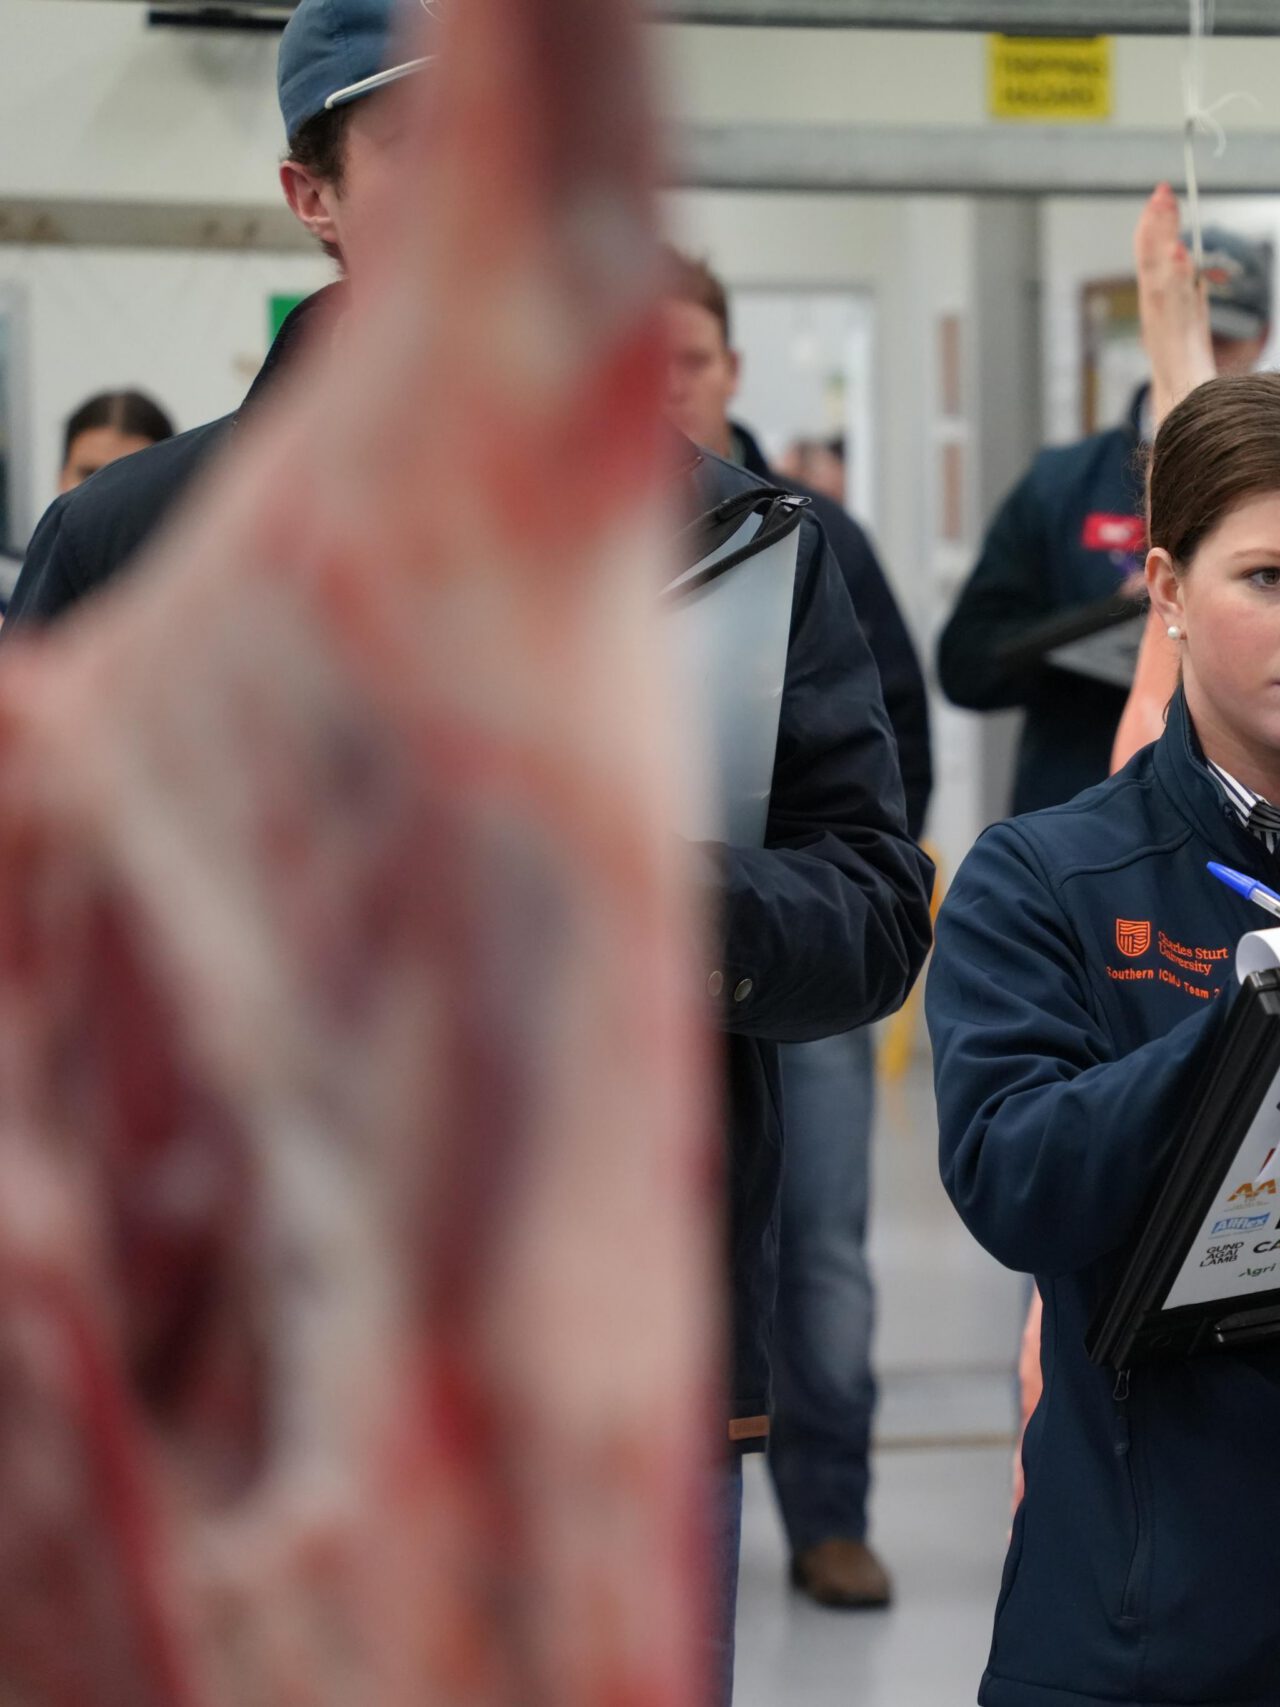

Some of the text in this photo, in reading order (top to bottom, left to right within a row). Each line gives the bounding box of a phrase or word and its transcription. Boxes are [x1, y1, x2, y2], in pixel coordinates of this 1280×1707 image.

[1158, 931, 1229, 960] Charles Sturt
[1158, 941, 1212, 976] University
[1106, 966, 1154, 980] Southern
[1159, 968, 1181, 987] ICMJ
[1184, 982, 1209, 999] Team
[1216, 1216, 1266, 1232] Allflex
[1205, 1249, 1238, 1260] AGAI
[1206, 1241, 1244, 1254] GUND
[1199, 1255, 1238, 1267] LAMB
[1238, 1263, 1277, 1277] Agri
